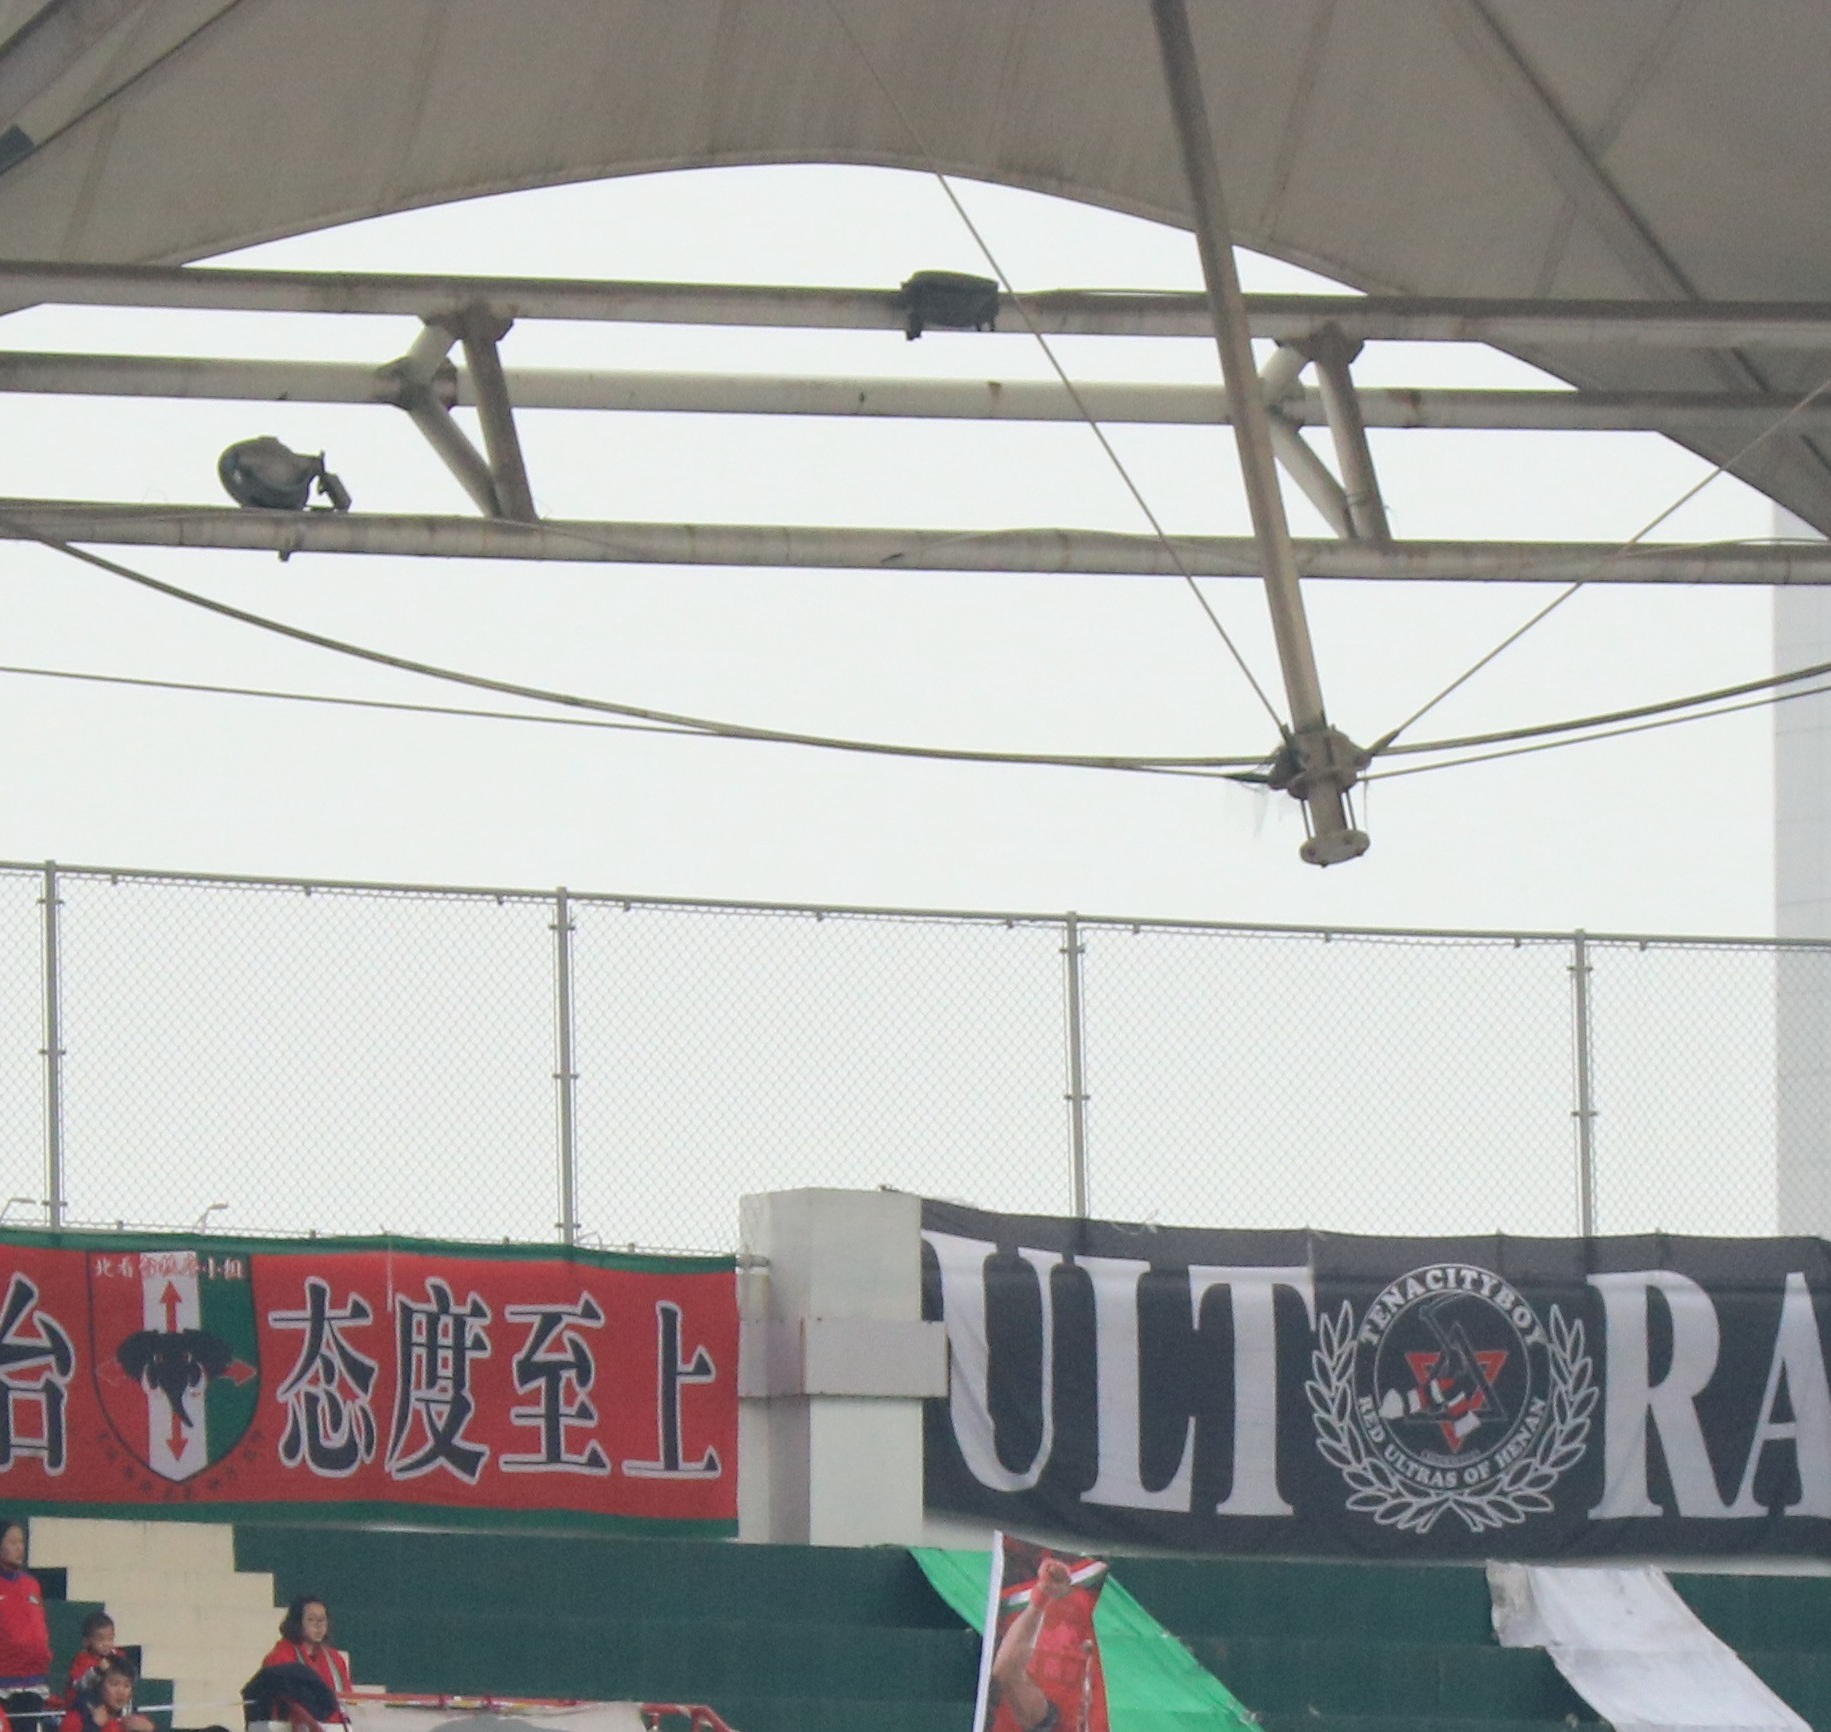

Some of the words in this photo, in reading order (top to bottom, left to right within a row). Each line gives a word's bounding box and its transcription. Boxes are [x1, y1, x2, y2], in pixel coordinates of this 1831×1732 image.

[1358, 1267, 1550, 1347] TENACITYBOY
[268, 1276, 722, 1485] 态度至上
[1383, 1444, 1459, 1488] ULTRAS
[1462, 1468, 1492, 1487] OF
[1494, 1397, 1548, 1471] HENAN
